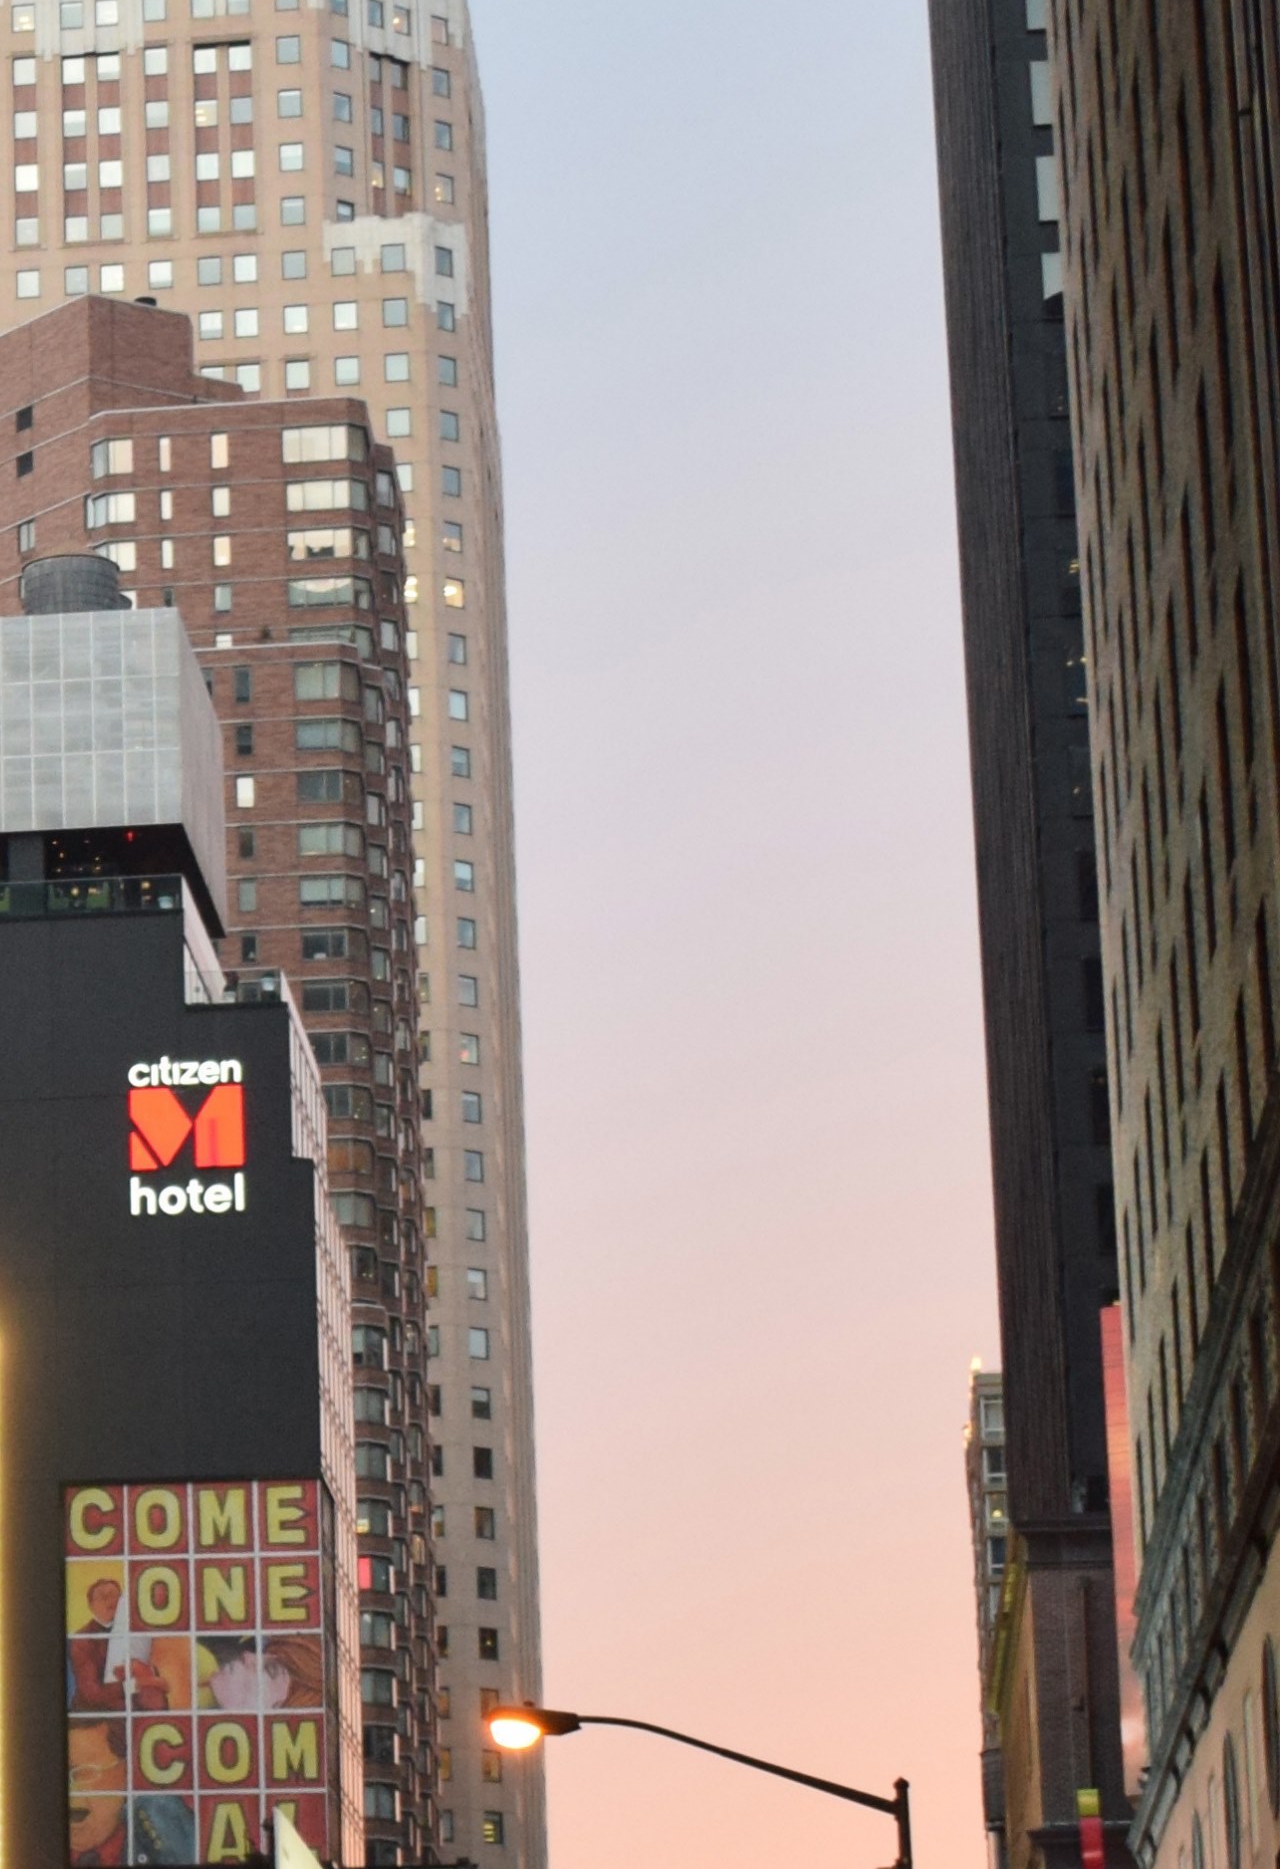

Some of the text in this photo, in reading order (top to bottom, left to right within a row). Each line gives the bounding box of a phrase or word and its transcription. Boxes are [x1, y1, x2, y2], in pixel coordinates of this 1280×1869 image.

[127, 1055, 242, 1088] citizen
[130, 1172, 245, 1216] hotel
[69, 1485, 307, 1551] COME
[137, 1563, 311, 1627] ONE
[139, 1720, 319, 1786] COM
